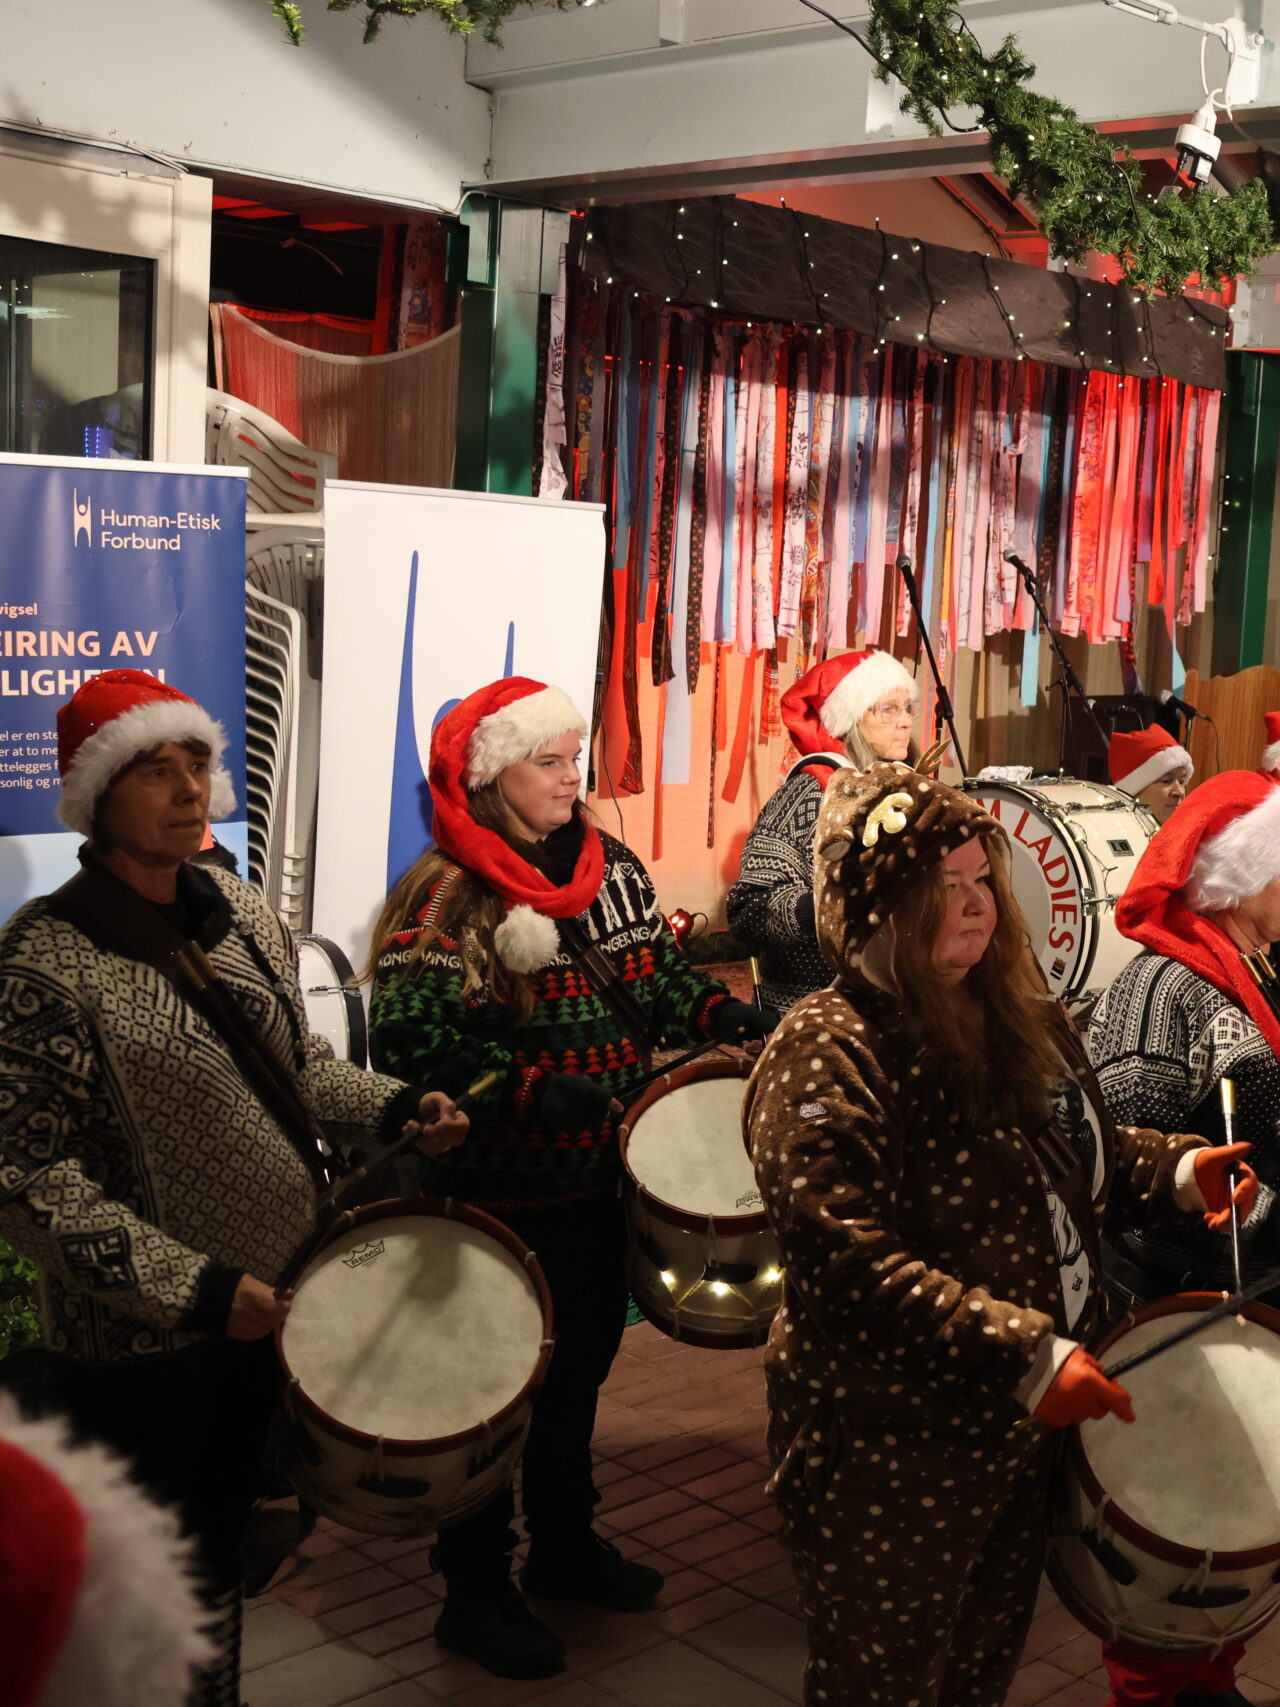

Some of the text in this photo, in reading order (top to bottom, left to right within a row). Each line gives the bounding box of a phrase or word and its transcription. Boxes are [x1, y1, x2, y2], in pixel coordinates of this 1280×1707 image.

[101, 508, 221, 531] Human-Etisk
[101, 531, 181, 550] Forbund
[0, 630, 158, 657] IRING AV
[11, 732, 23, 741] er
[26, 732, 40, 741] en
[12, 746, 24, 757] at
[26, 746, 39, 756] to
[36, 778, 51, 789] og
[1013, 810, 1078, 953] LADIES
